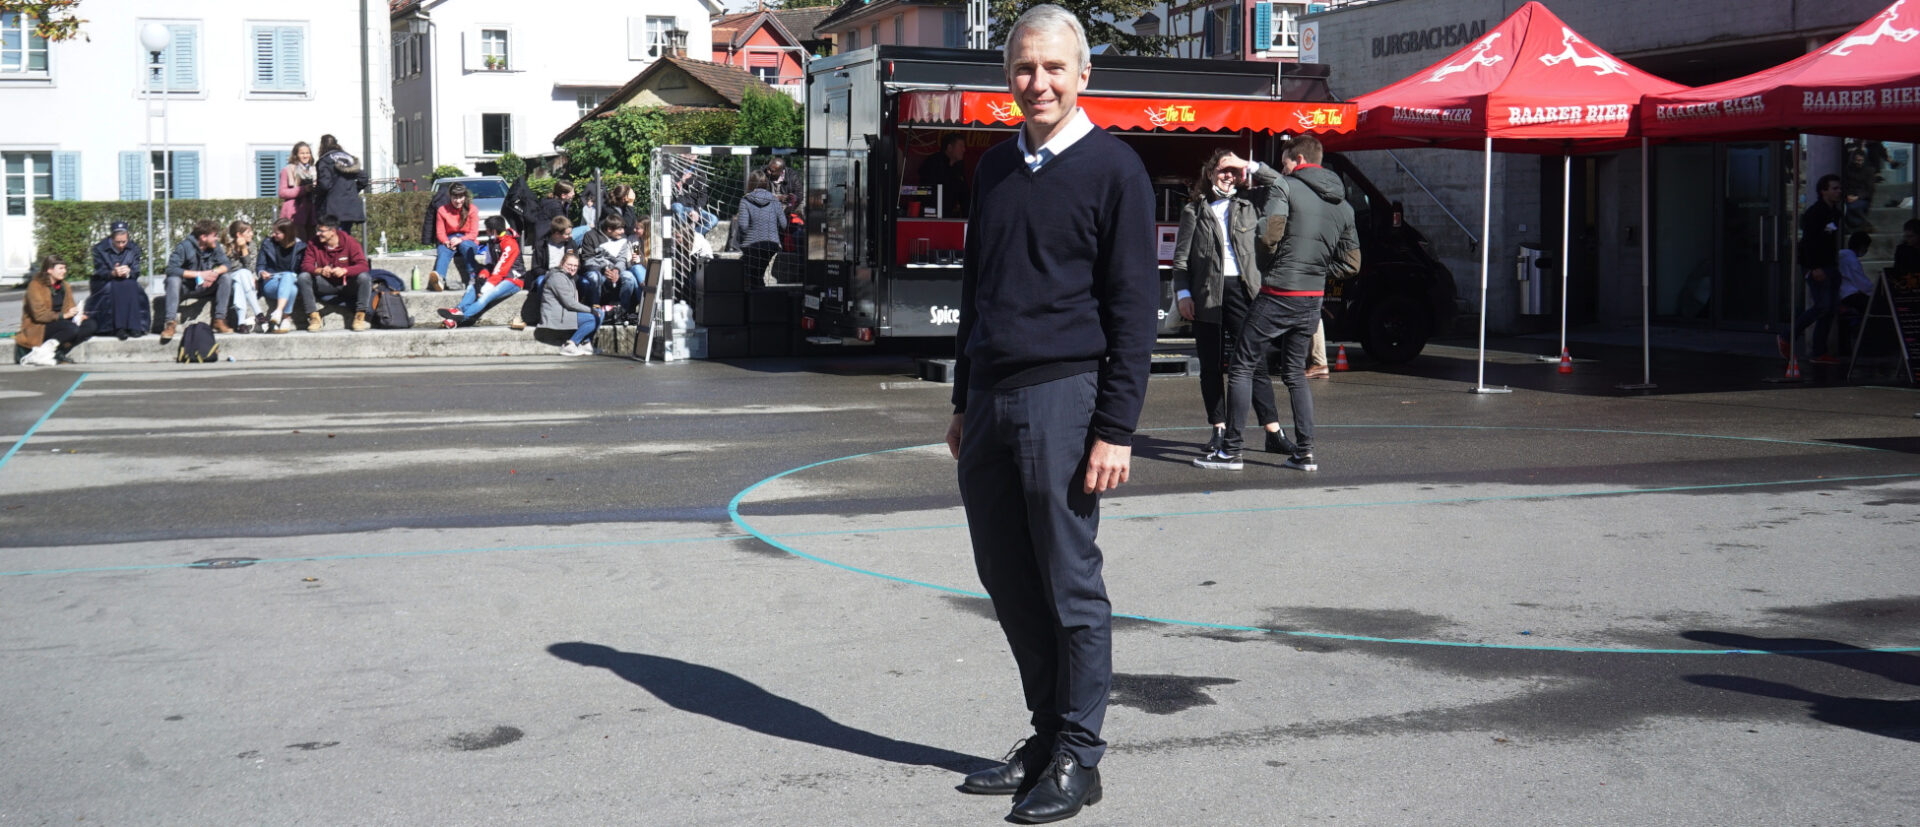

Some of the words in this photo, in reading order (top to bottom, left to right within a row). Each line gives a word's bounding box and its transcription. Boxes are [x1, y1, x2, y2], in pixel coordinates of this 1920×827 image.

[1656, 101, 1720, 121] BAARER
[1723, 95, 1765, 113] BIER
[1802, 90, 1877, 108] BAARER
[1161, 104, 1179, 122] the
[1176, 105, 1196, 122] Thai
[1308, 108, 1326, 125] the
[1393, 105, 1440, 123] BAARER
[1441, 108, 1473, 123] BIER
[1508, 106, 1583, 124] BAARER
[1585, 104, 1630, 121] BIER
[930, 305, 960, 326] Spice
